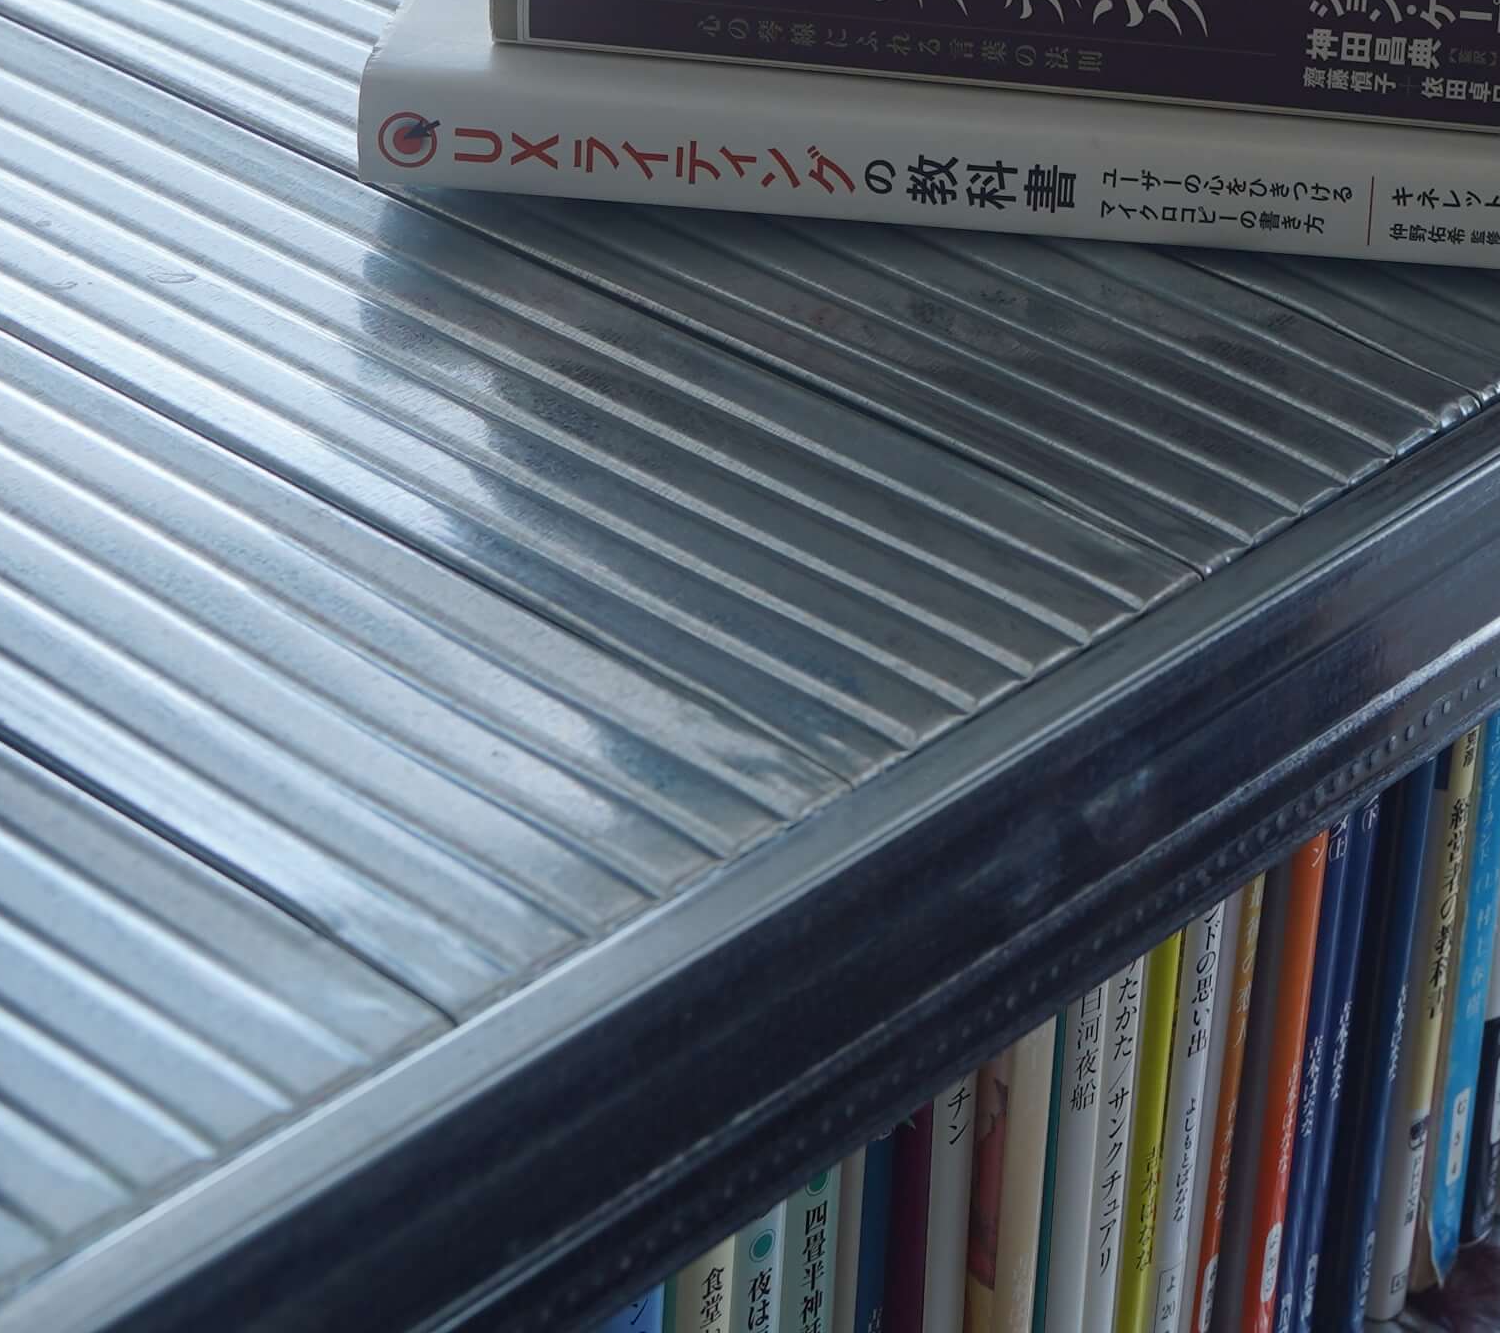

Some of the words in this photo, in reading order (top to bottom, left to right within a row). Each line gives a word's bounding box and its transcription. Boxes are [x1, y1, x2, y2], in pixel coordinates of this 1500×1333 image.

[696, 17, 1104, 73] 心の琴線にふれる言葉の法則
[1305, 28, 1441, 68] 神田昌典
[453, 126, 1077, 213] UXライティングの教科書
[1102, 169, 1354, 205] ユーザーの心をひきつける
[1100, 201, 1326, 234] マイクロコピーの書き方
[1389, 222, 1467, 245] 仲野佑希
[1068, 986, 1102, 1113] 白河夜船
[1172, 1098, 1198, 1223] よしもとばなな
[1134, 1146, 1163, 1272] 吉本ばなな
[700, 1266, 726, 1333] 食堂
[747, 1267, 773, 1333] 夜は
